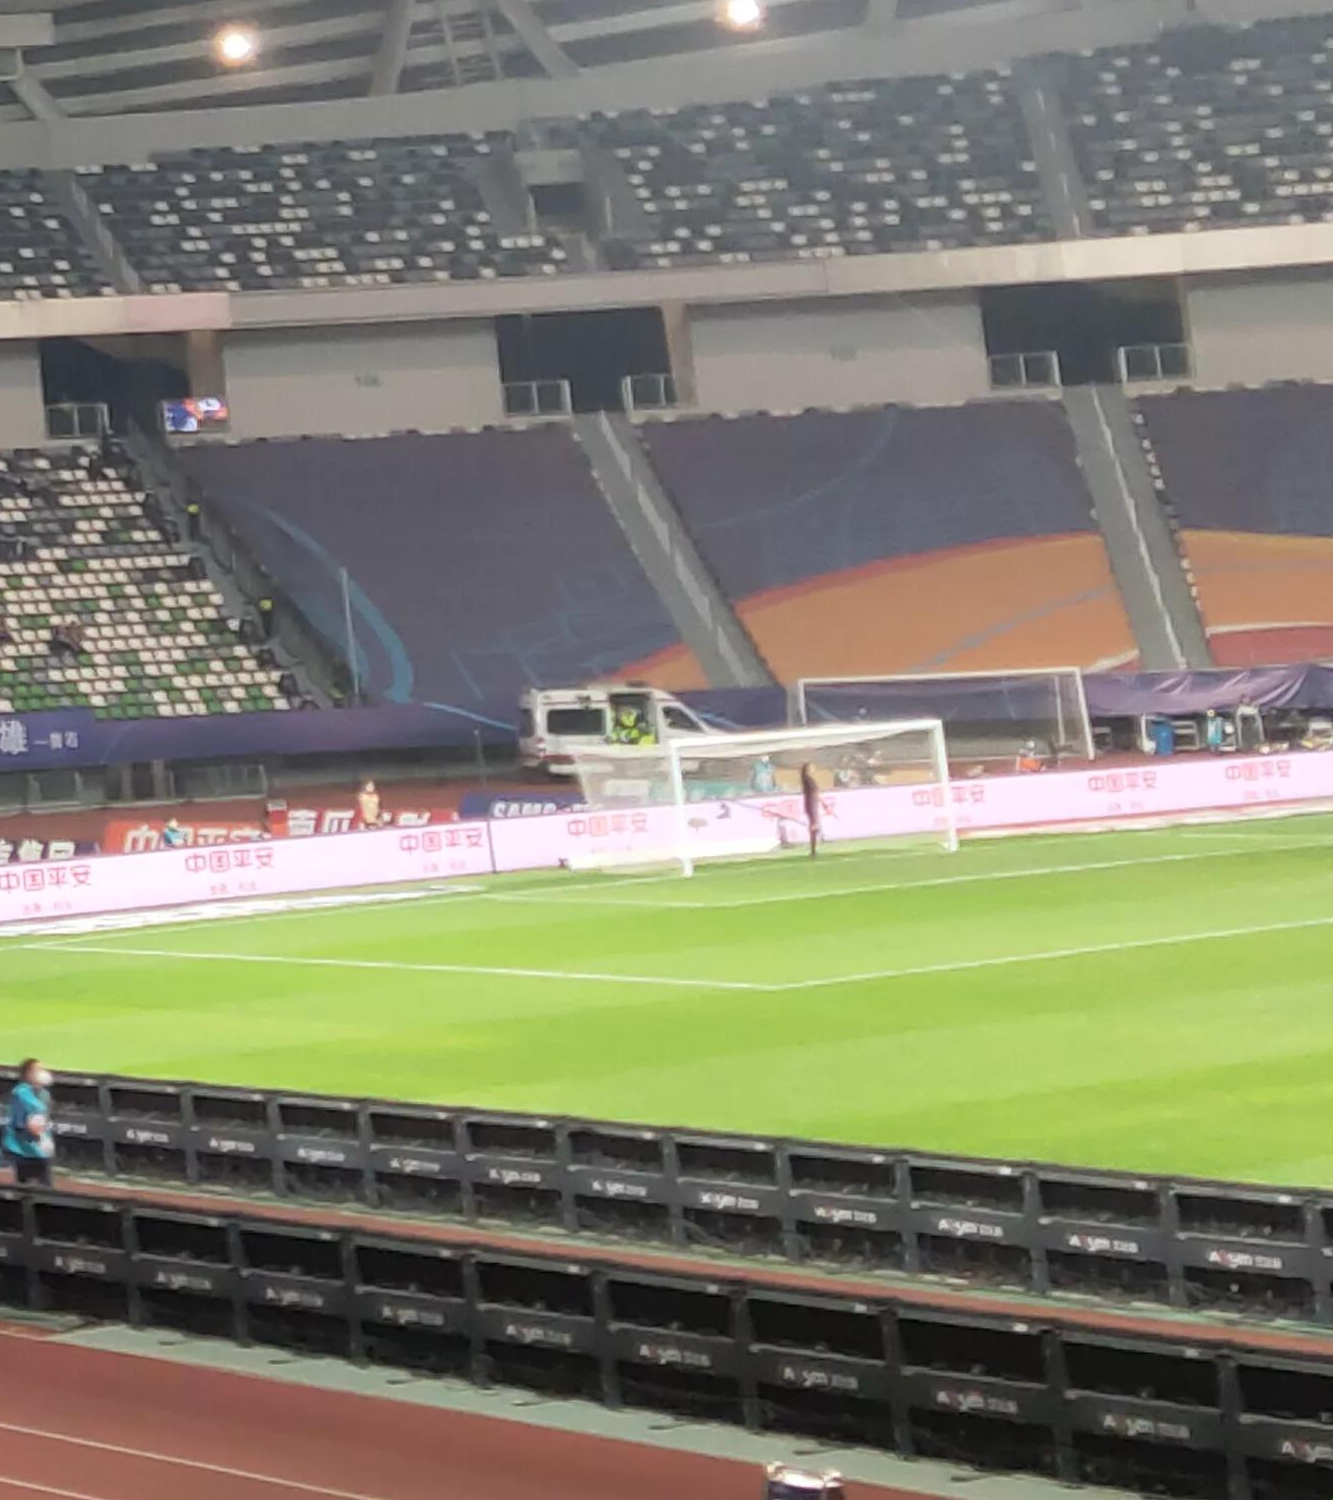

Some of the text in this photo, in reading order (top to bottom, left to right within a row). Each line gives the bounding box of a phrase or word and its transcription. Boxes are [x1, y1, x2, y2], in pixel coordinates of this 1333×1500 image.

[399, 828, 483, 855] 中国平安
[185, 848, 274, 873] 中国平安
